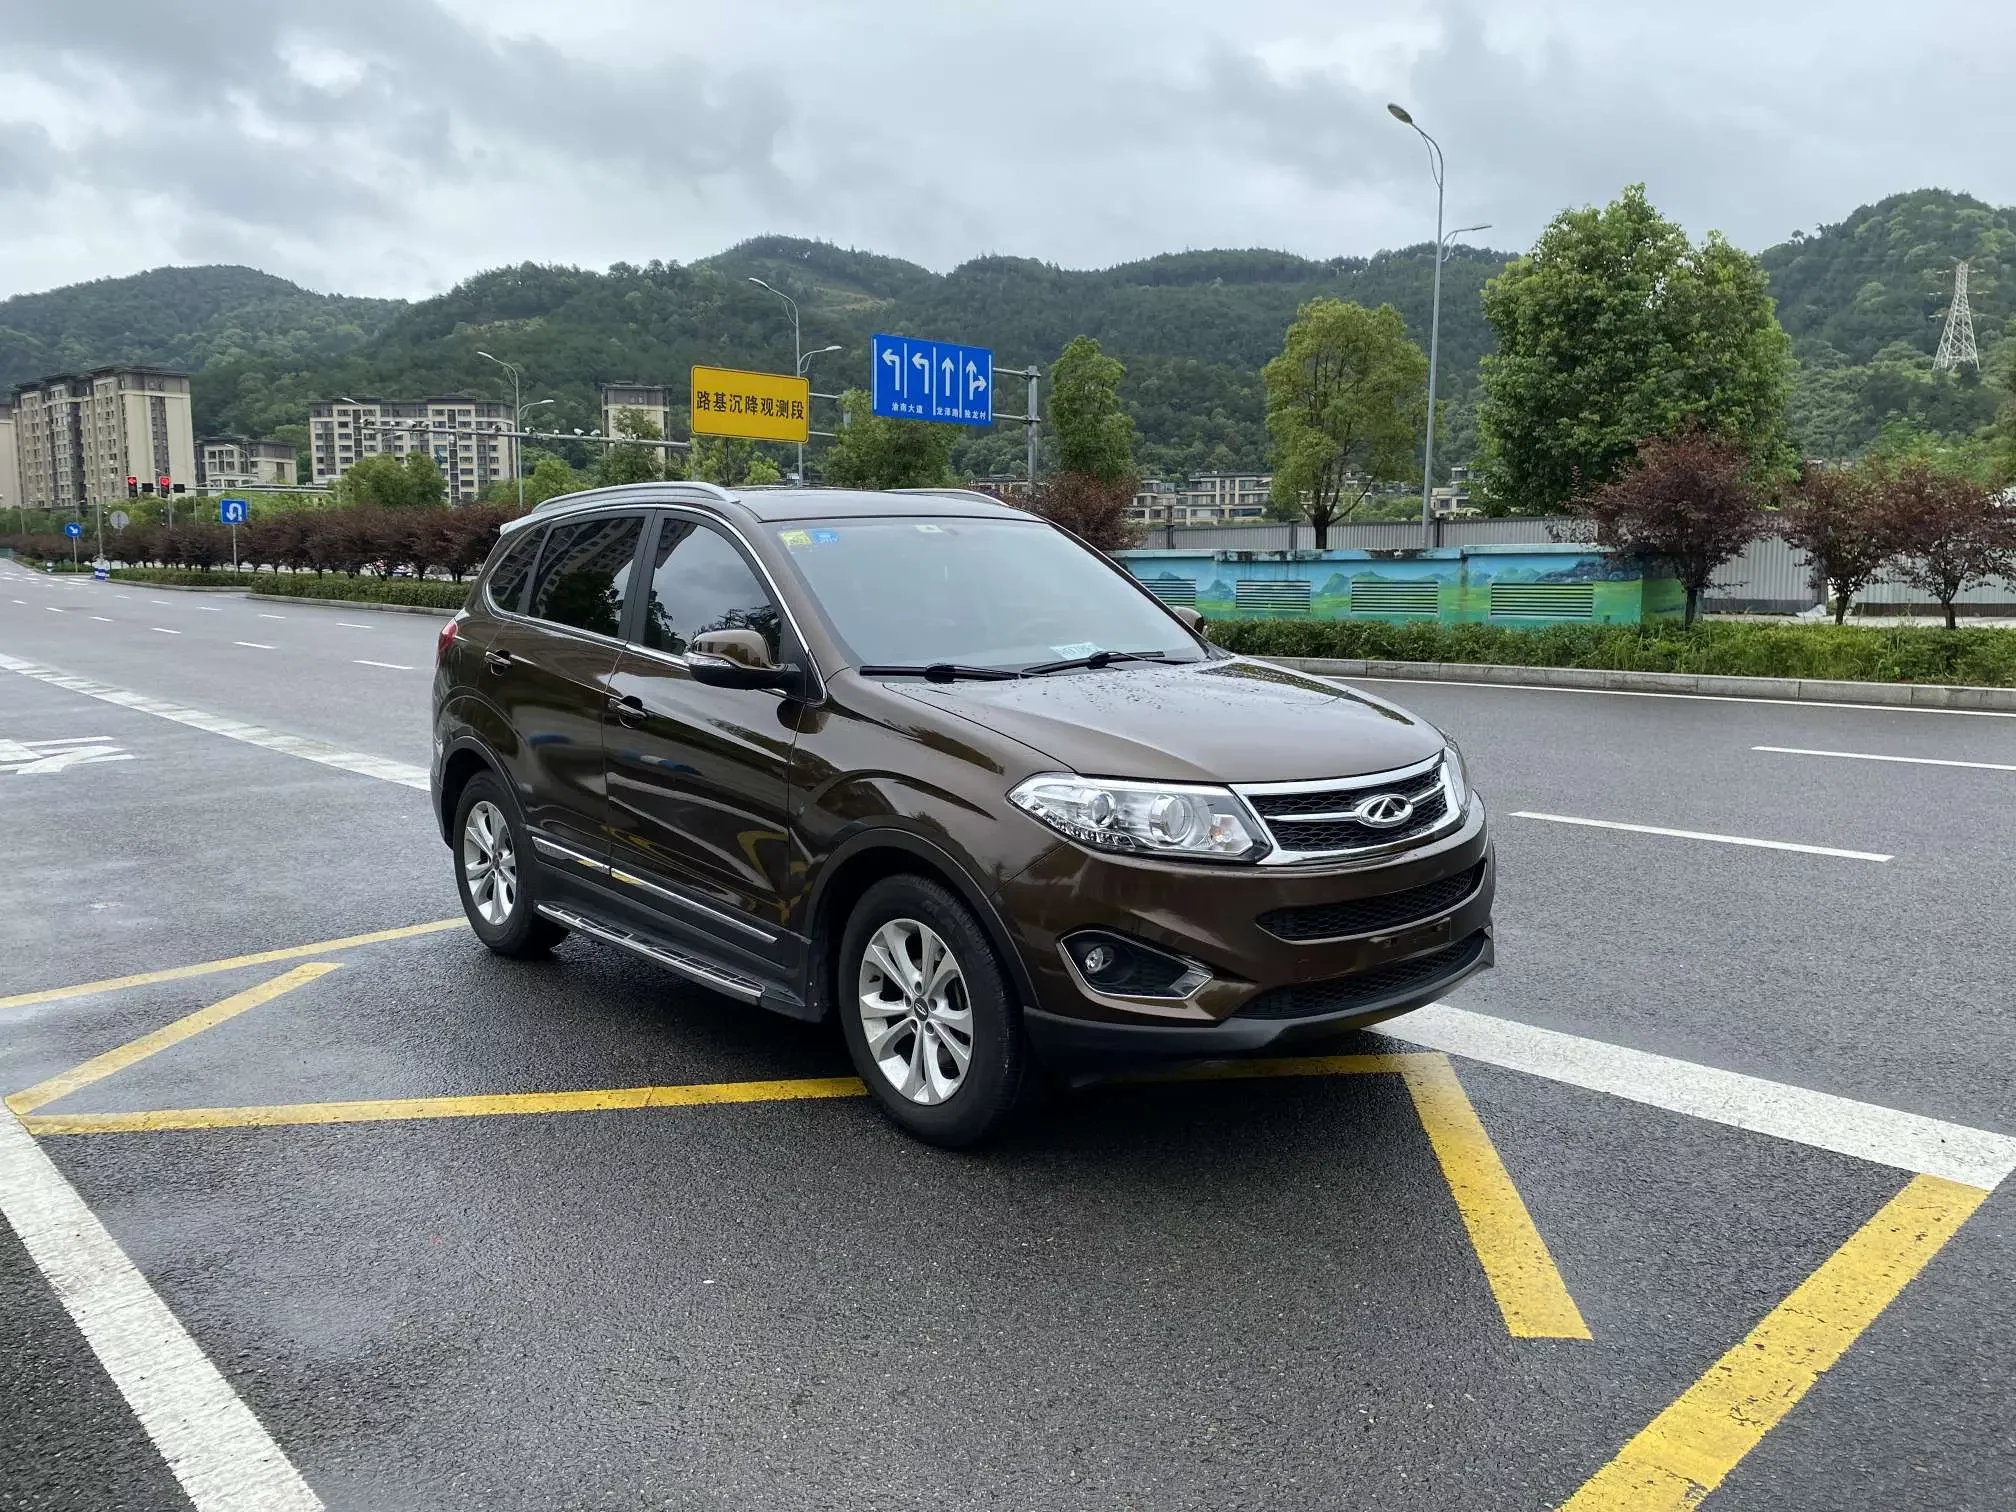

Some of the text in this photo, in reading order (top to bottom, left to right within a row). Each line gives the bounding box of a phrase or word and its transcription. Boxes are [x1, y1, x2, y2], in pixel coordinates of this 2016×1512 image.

[697, 390, 804, 420] 路基沉降观测段
